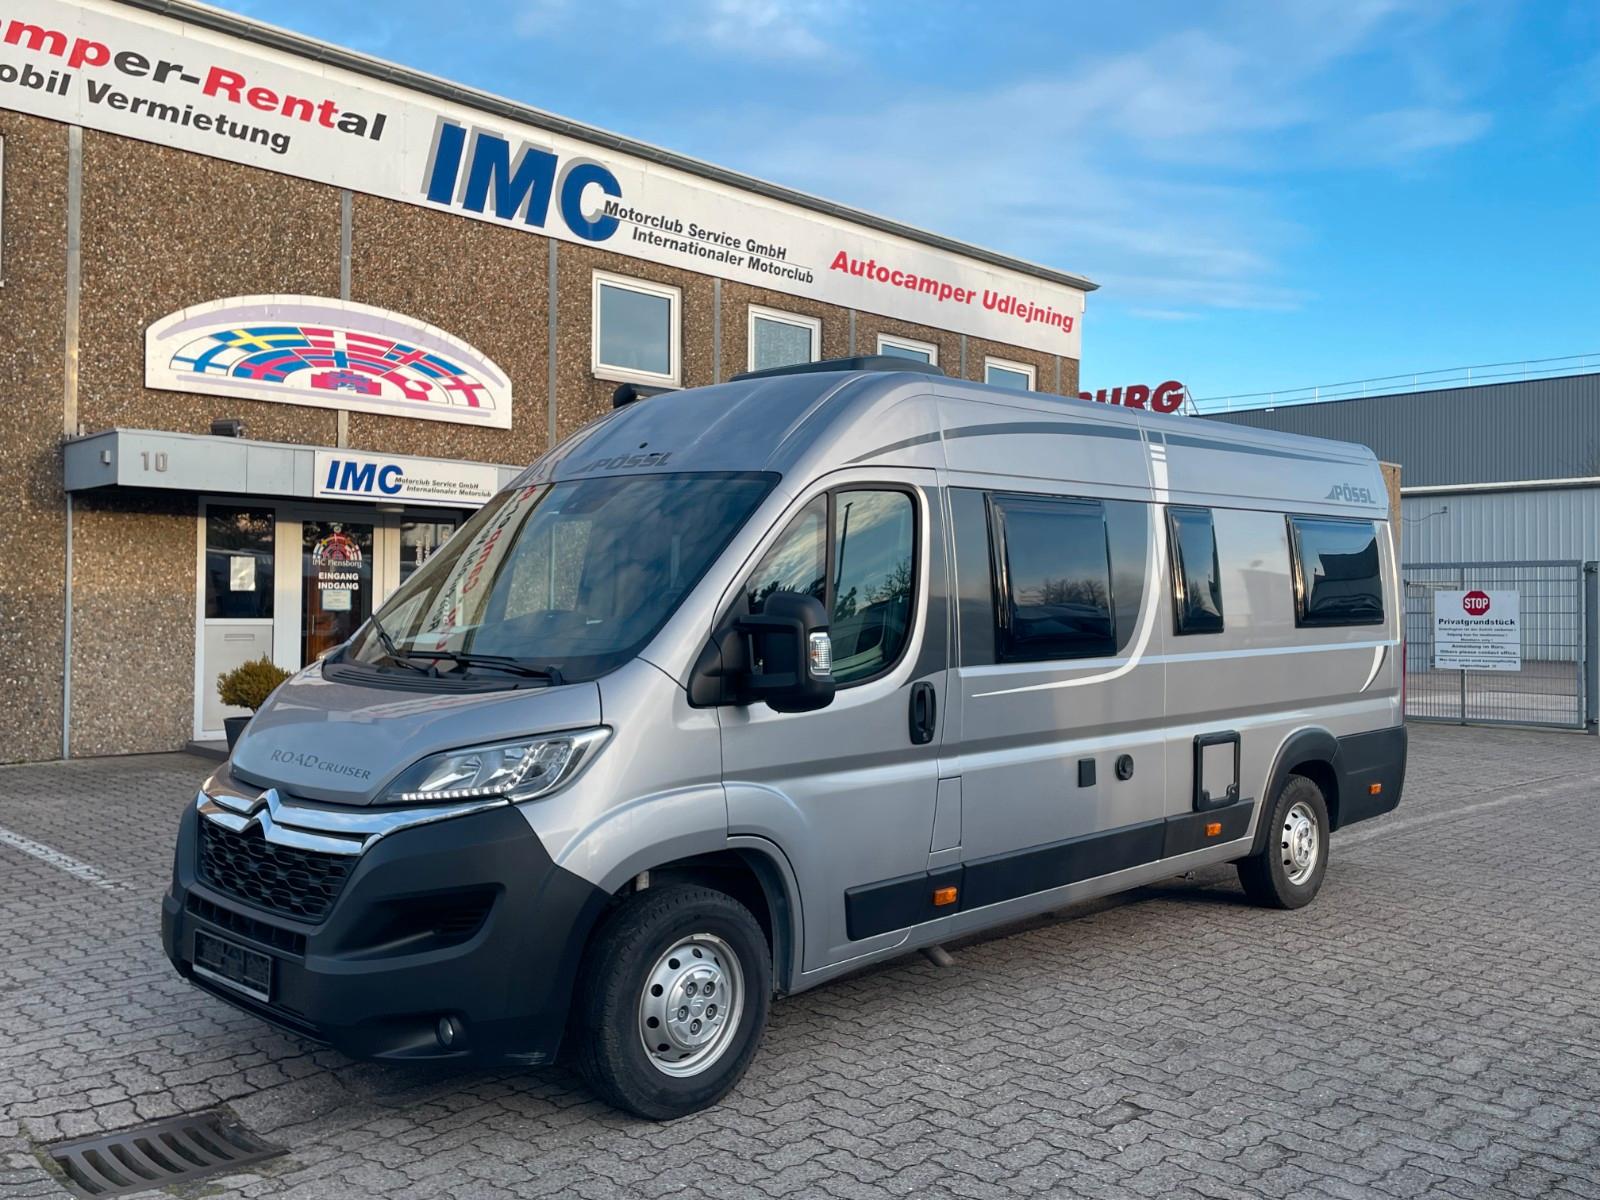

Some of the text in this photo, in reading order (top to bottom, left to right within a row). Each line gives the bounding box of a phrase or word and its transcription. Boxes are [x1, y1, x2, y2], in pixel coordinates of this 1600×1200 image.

[0, 19, 387, 141] mper-Rental
[0, 63, 291, 154] obil Vermietung
[422, 116, 623, 242] IMC
[603, 200, 787, 260] Motorclub Service GmbH
[632, 226, 814, 284] Internationaler Motorclub
[830, 251, 1074, 333] Autocamper Udlejning
[140, 451, 168, 472] 10
[326, 460, 404, 494] IMC
[395, 476, 479, 490] Motorclub Service GmbH
[406, 485, 492, 498] Internationaler Motorclub
[1333, 483, 1376, 504] PÖSSL
[317, 581, 360, 590] INDGANG
[318, 571, 359, 581] EINGANG
[1464, 597, 1489, 609] STOP
[1439, 618, 1515, 626] Privatgrundstück
[271, 749, 371, 780] ROAD CRUISER
